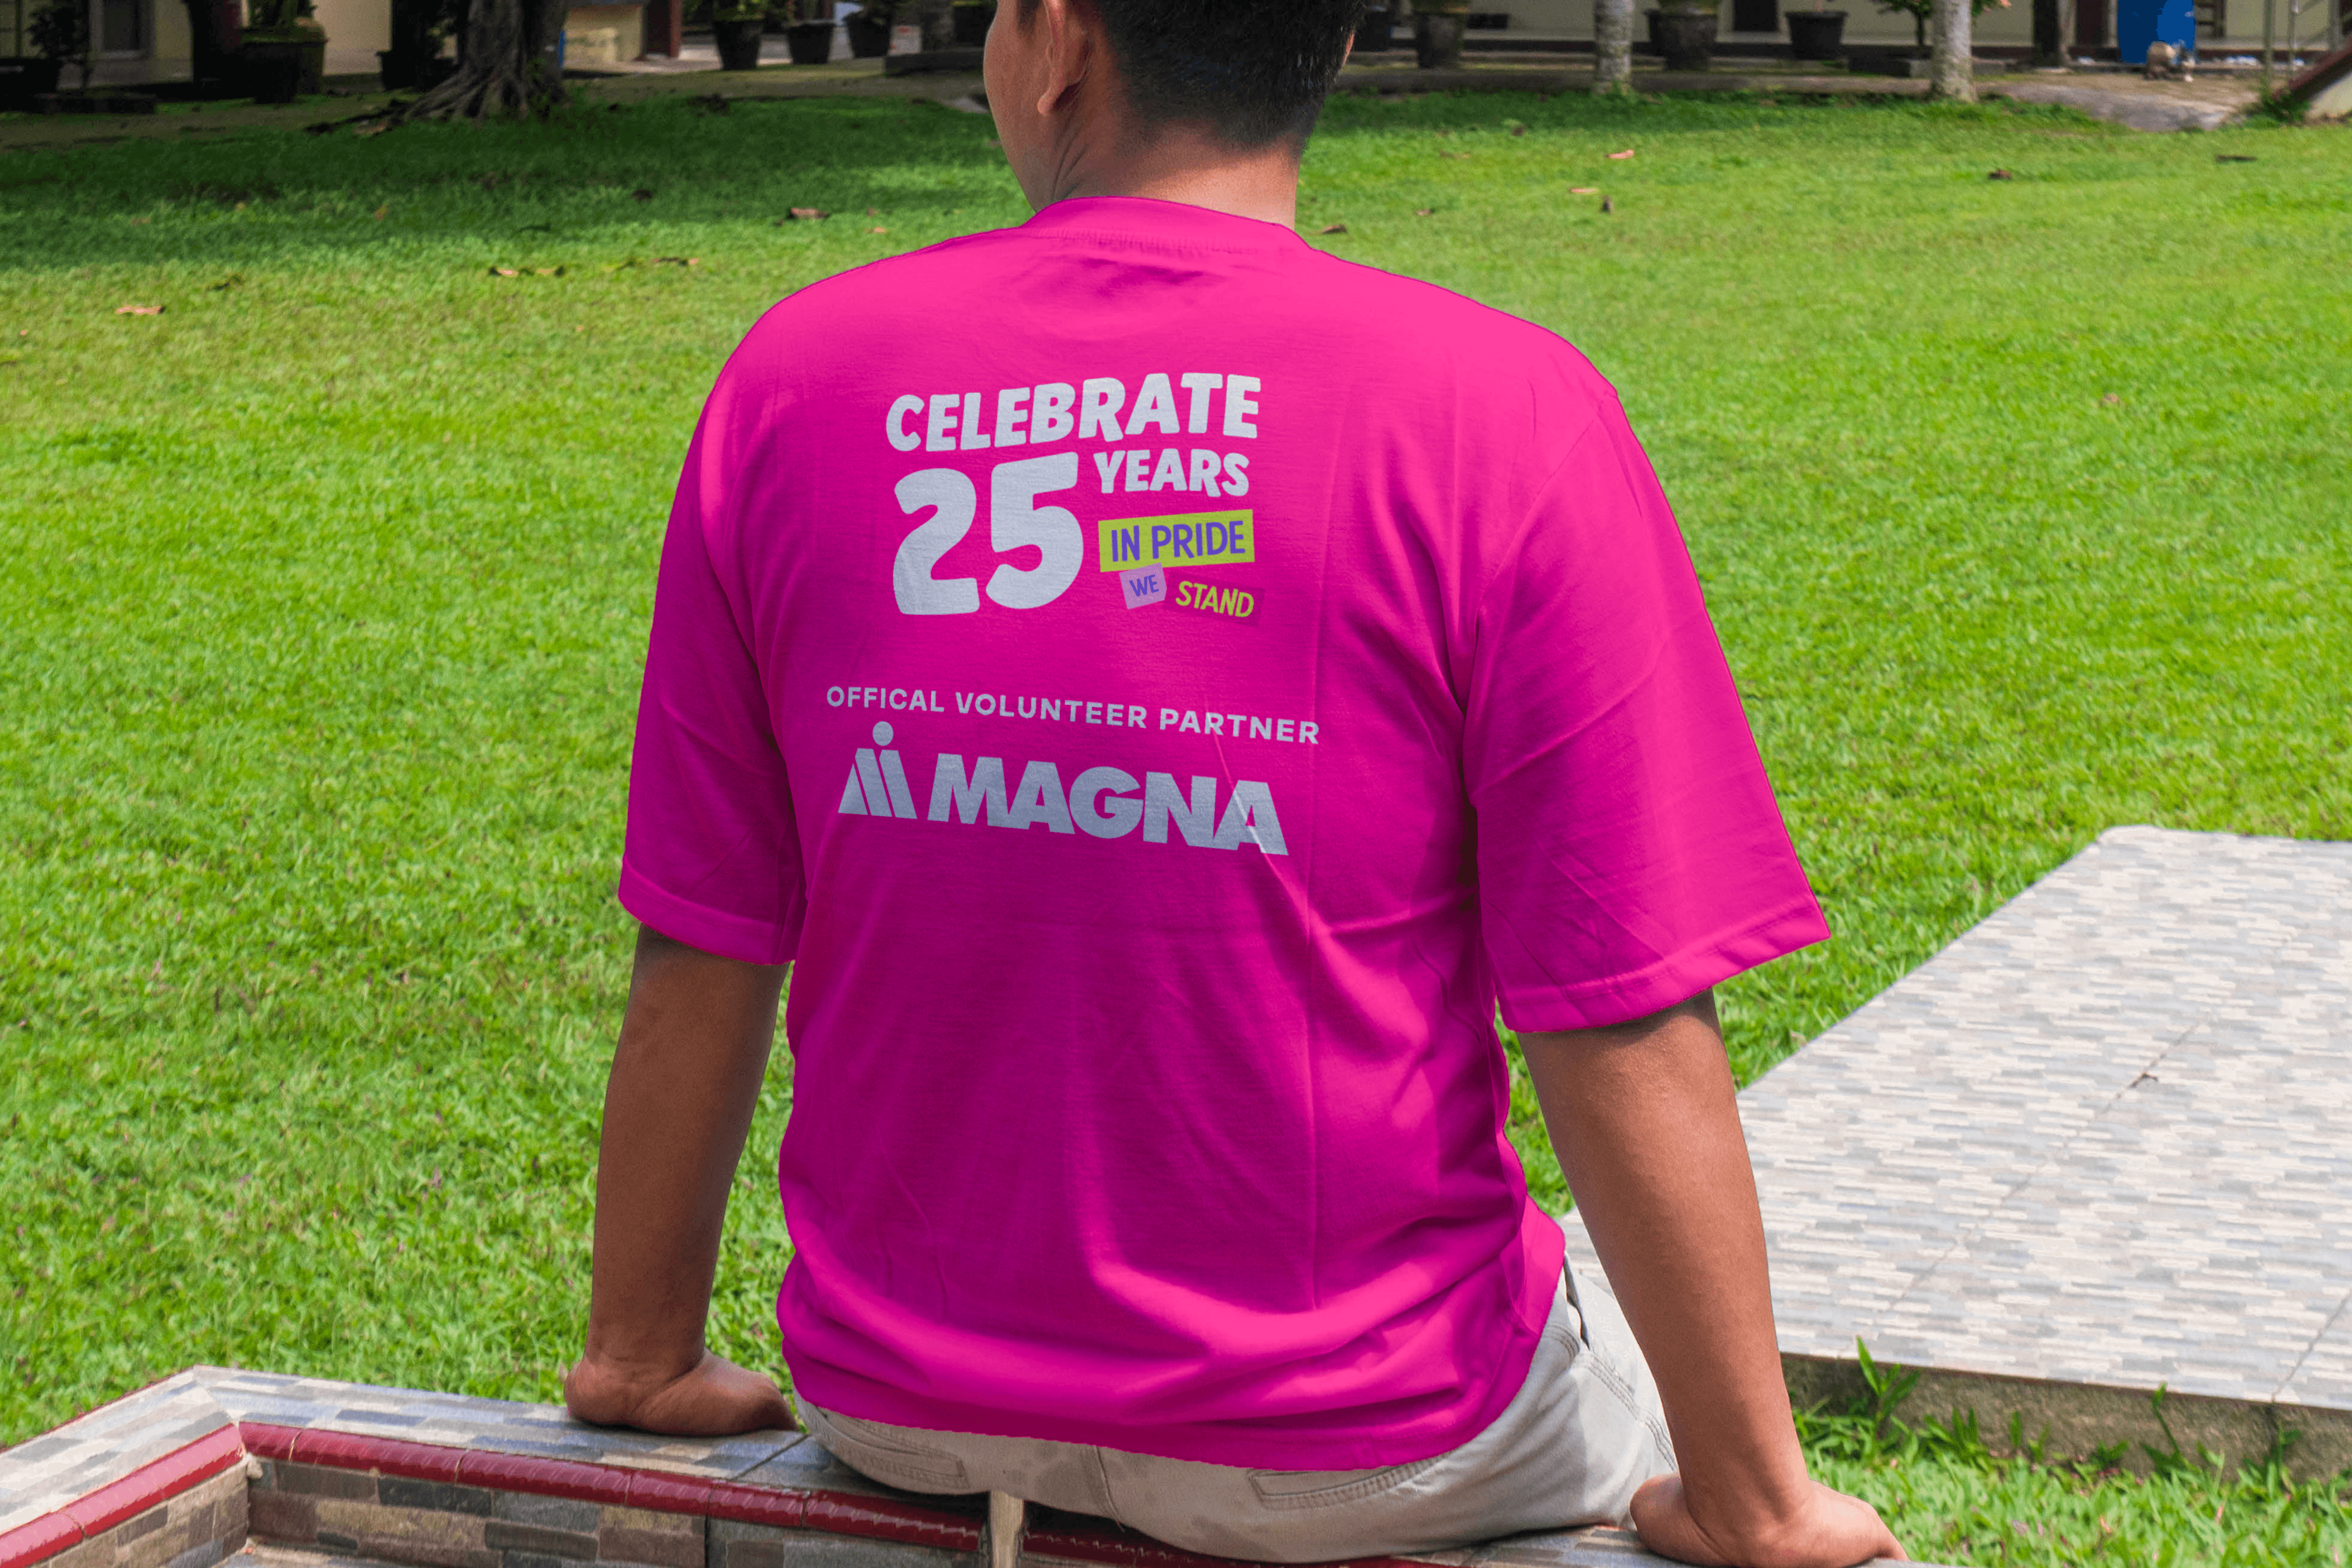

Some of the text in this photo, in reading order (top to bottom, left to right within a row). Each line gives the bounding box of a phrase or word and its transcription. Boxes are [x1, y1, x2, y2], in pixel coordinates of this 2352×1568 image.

[886, 372, 1261, 452] CELEBRATE
[1093, 448, 1250, 497] YEARS
[893, 452, 1084, 615] 25
[1111, 520, 1246, 562] IN PRIDE
[1129, 574, 1159, 597] WE
[1175, 580, 1254, 618] STAND
[826, 686, 1320, 745] OFFICAL VOLUNTEER PARTNER
[927, 753, 1289, 856] MAGNA
